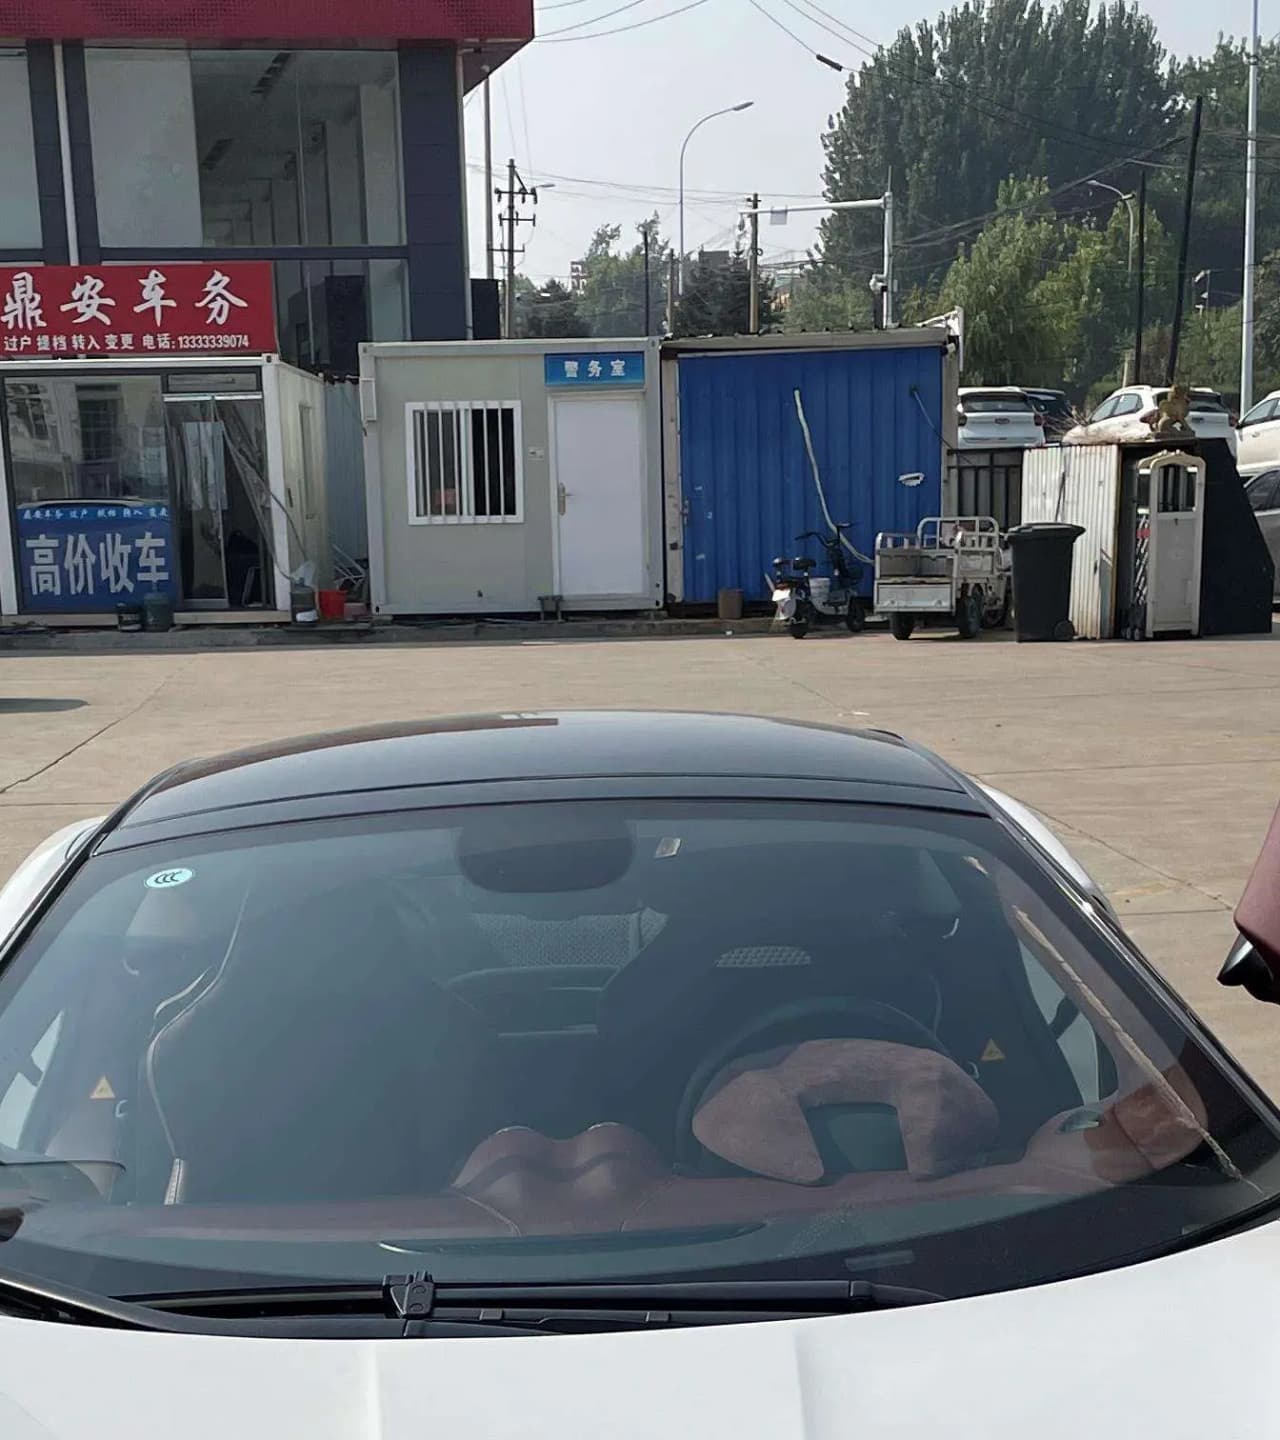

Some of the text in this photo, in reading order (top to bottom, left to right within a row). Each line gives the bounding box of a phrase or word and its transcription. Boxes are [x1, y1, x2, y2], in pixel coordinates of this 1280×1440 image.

[0, 269, 249, 331] 鼎安车务
[3, 336, 32, 351] 过户
[37, 335, 67, 351] 提档
[71, 335, 100, 350] 转入
[104, 334, 134, 350] 变更
[25, 531, 169, 595] 高价收车
